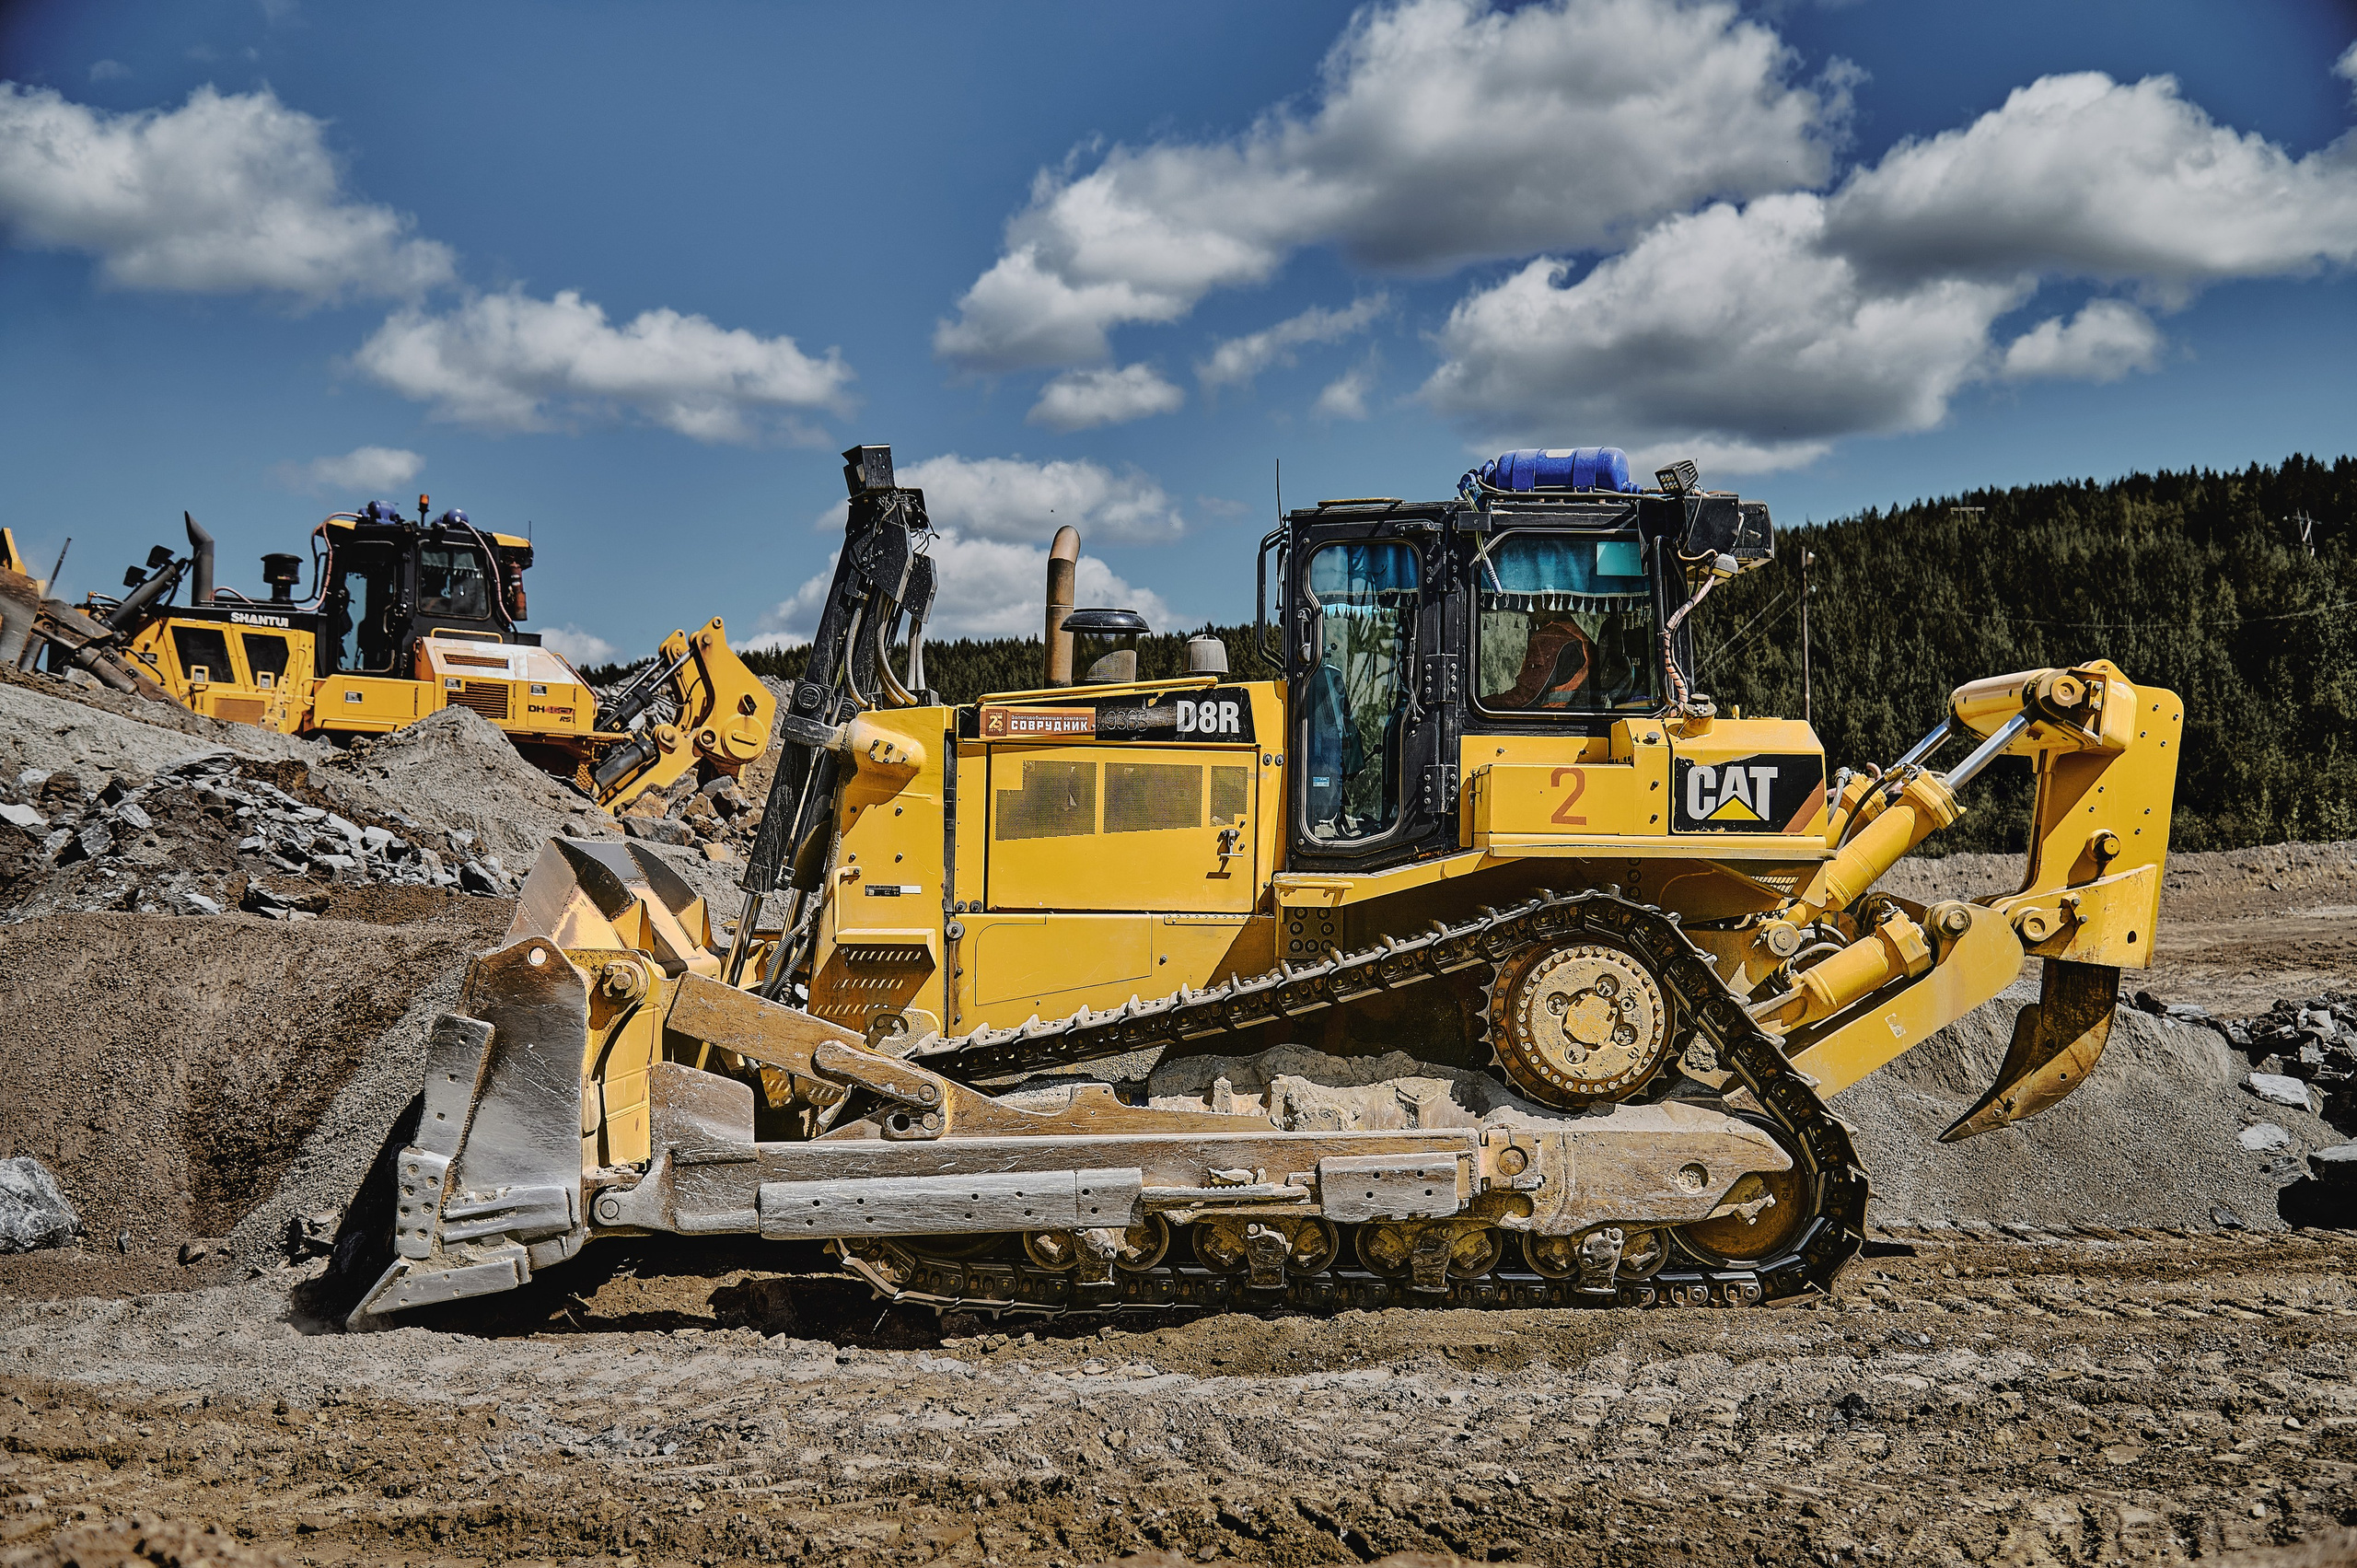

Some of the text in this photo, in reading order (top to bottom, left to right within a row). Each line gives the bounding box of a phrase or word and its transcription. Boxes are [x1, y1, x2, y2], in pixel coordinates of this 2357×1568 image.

[230, 611, 289, 627] SHANTUI
[1011, 720, 1088, 732] СОВРУДНИК
[1177, 701, 1240, 734] D8R
[1550, 767, 1587, 826] 2
[1687, 766, 1779, 820] CAT
